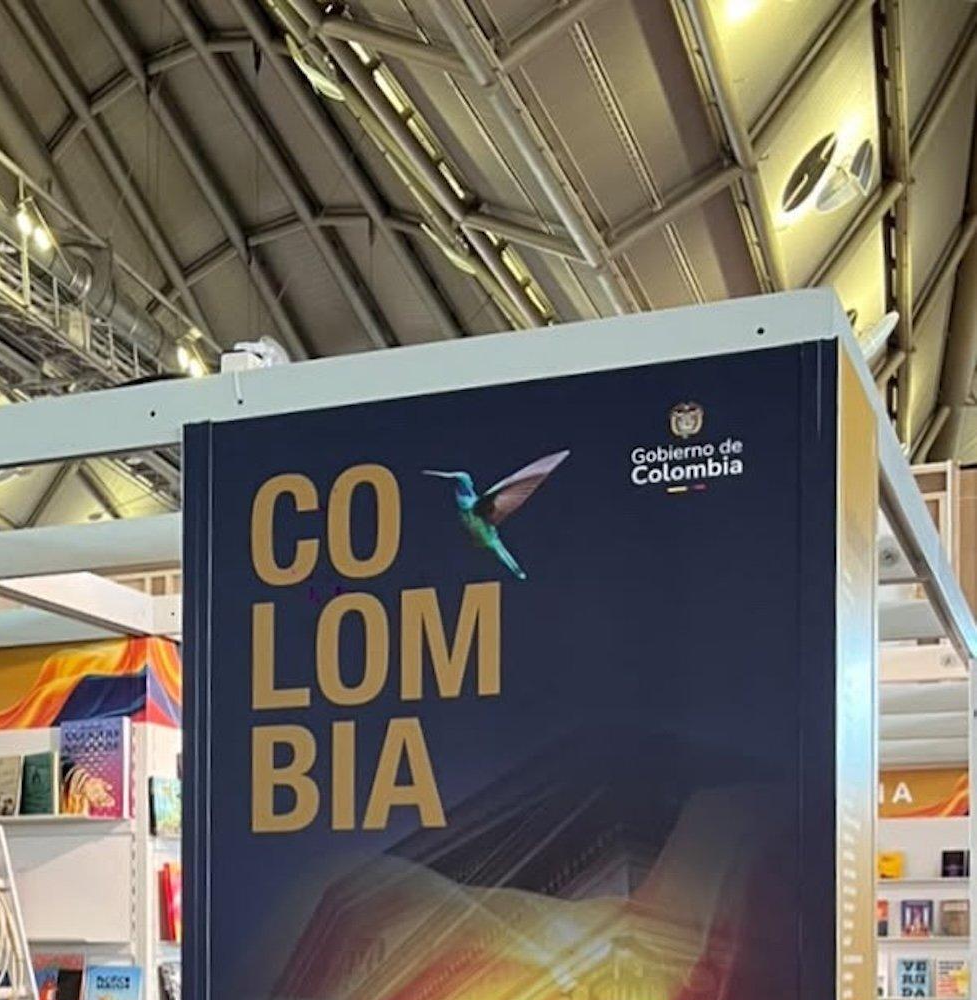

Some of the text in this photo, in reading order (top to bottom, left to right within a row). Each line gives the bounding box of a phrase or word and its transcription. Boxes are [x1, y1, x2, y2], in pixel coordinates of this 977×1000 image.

[631, 438, 743, 465] Gobierno de
[631, 456, 743, 485] Colombia
[250, 463, 402, 586] CO
[251, 581, 502, 711] LOM
[251, 716, 448, 834] BIA
